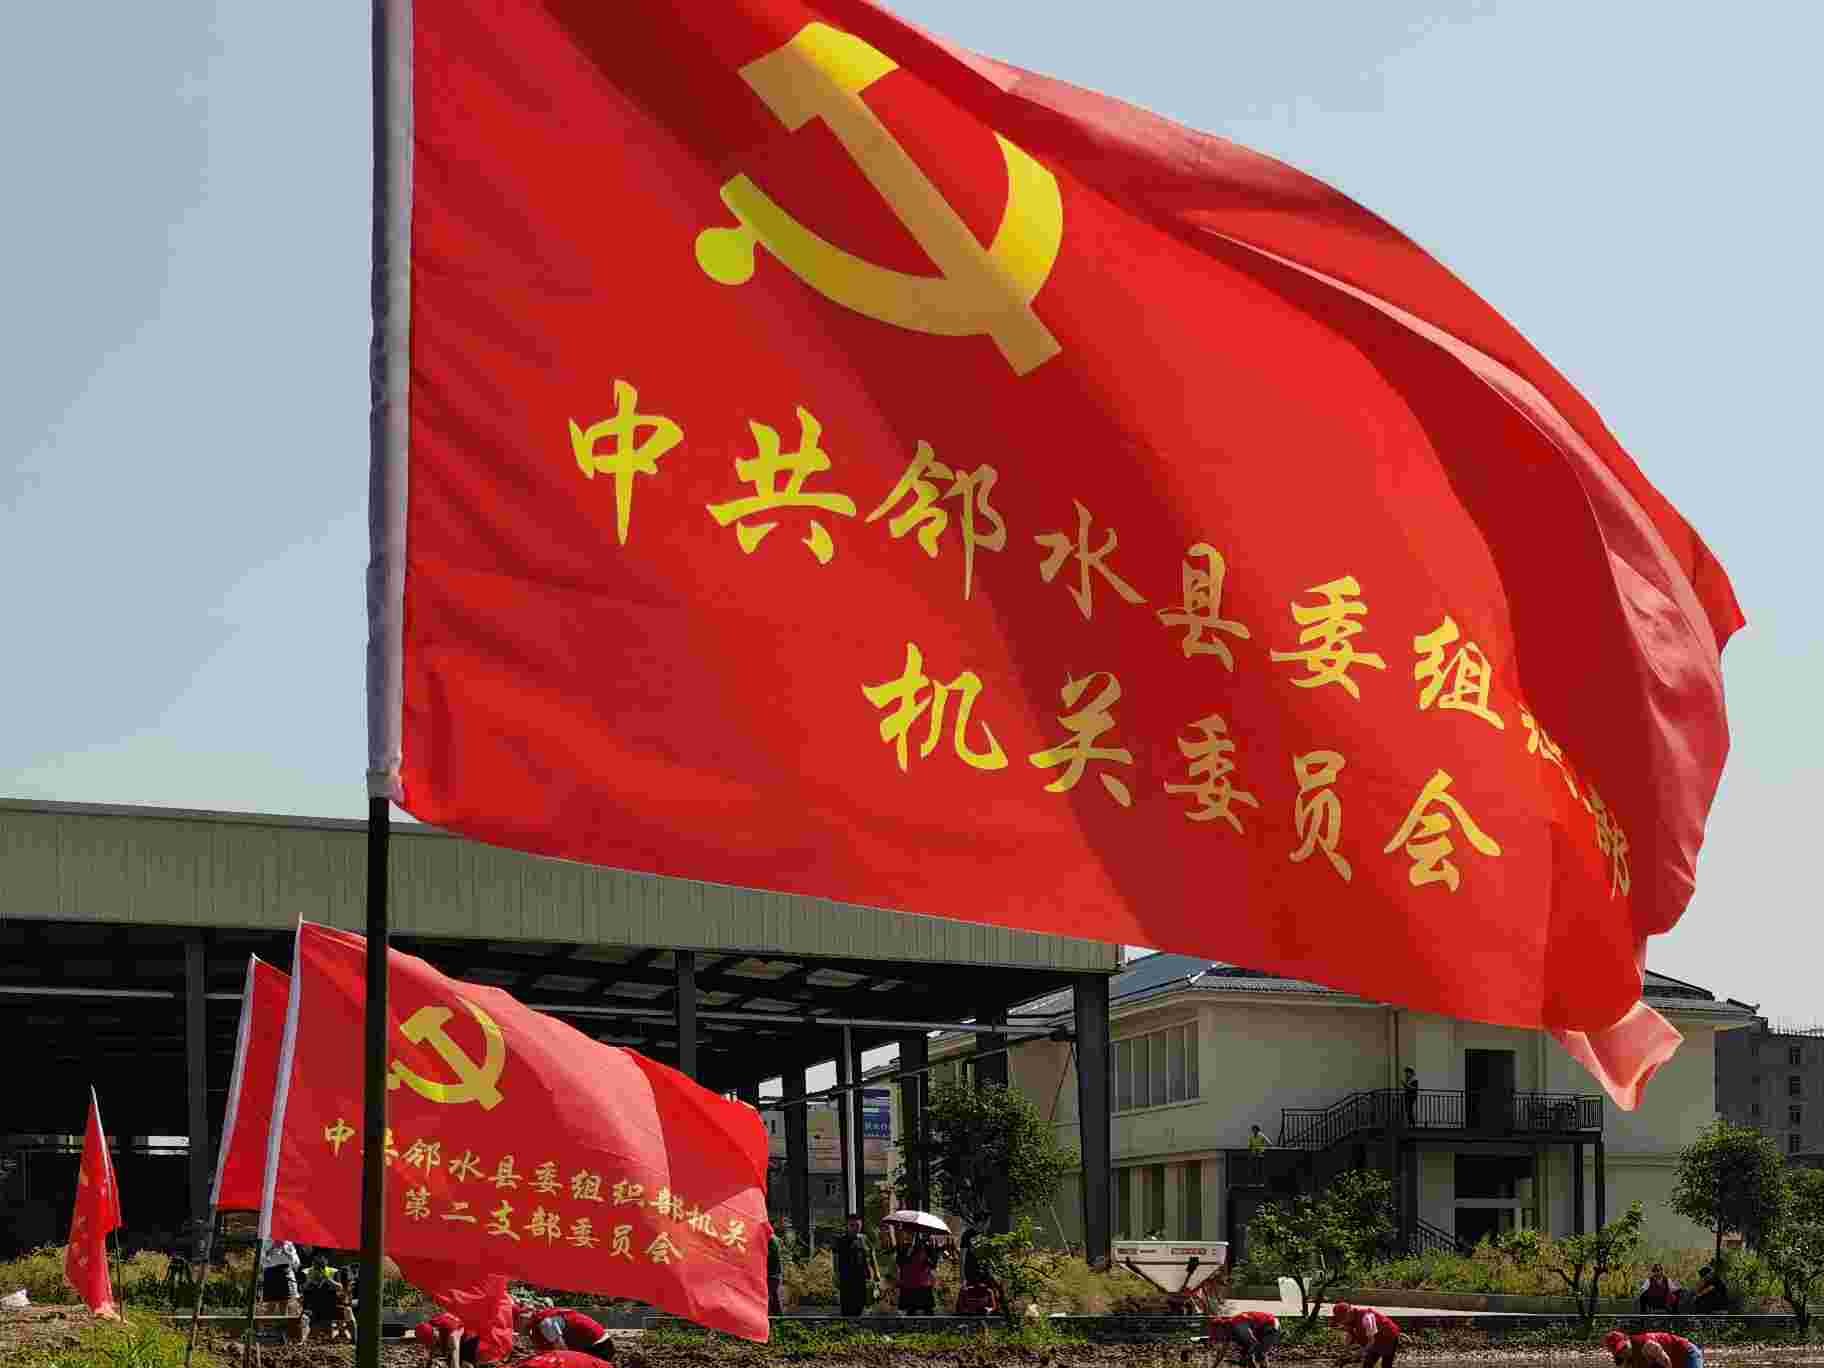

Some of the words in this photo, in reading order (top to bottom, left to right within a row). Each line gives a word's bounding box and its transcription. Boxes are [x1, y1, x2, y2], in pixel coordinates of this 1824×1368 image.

[862, 642, 1504, 892] 机关委员会
[403, 1185, 686, 1266] 第二支部委员会
